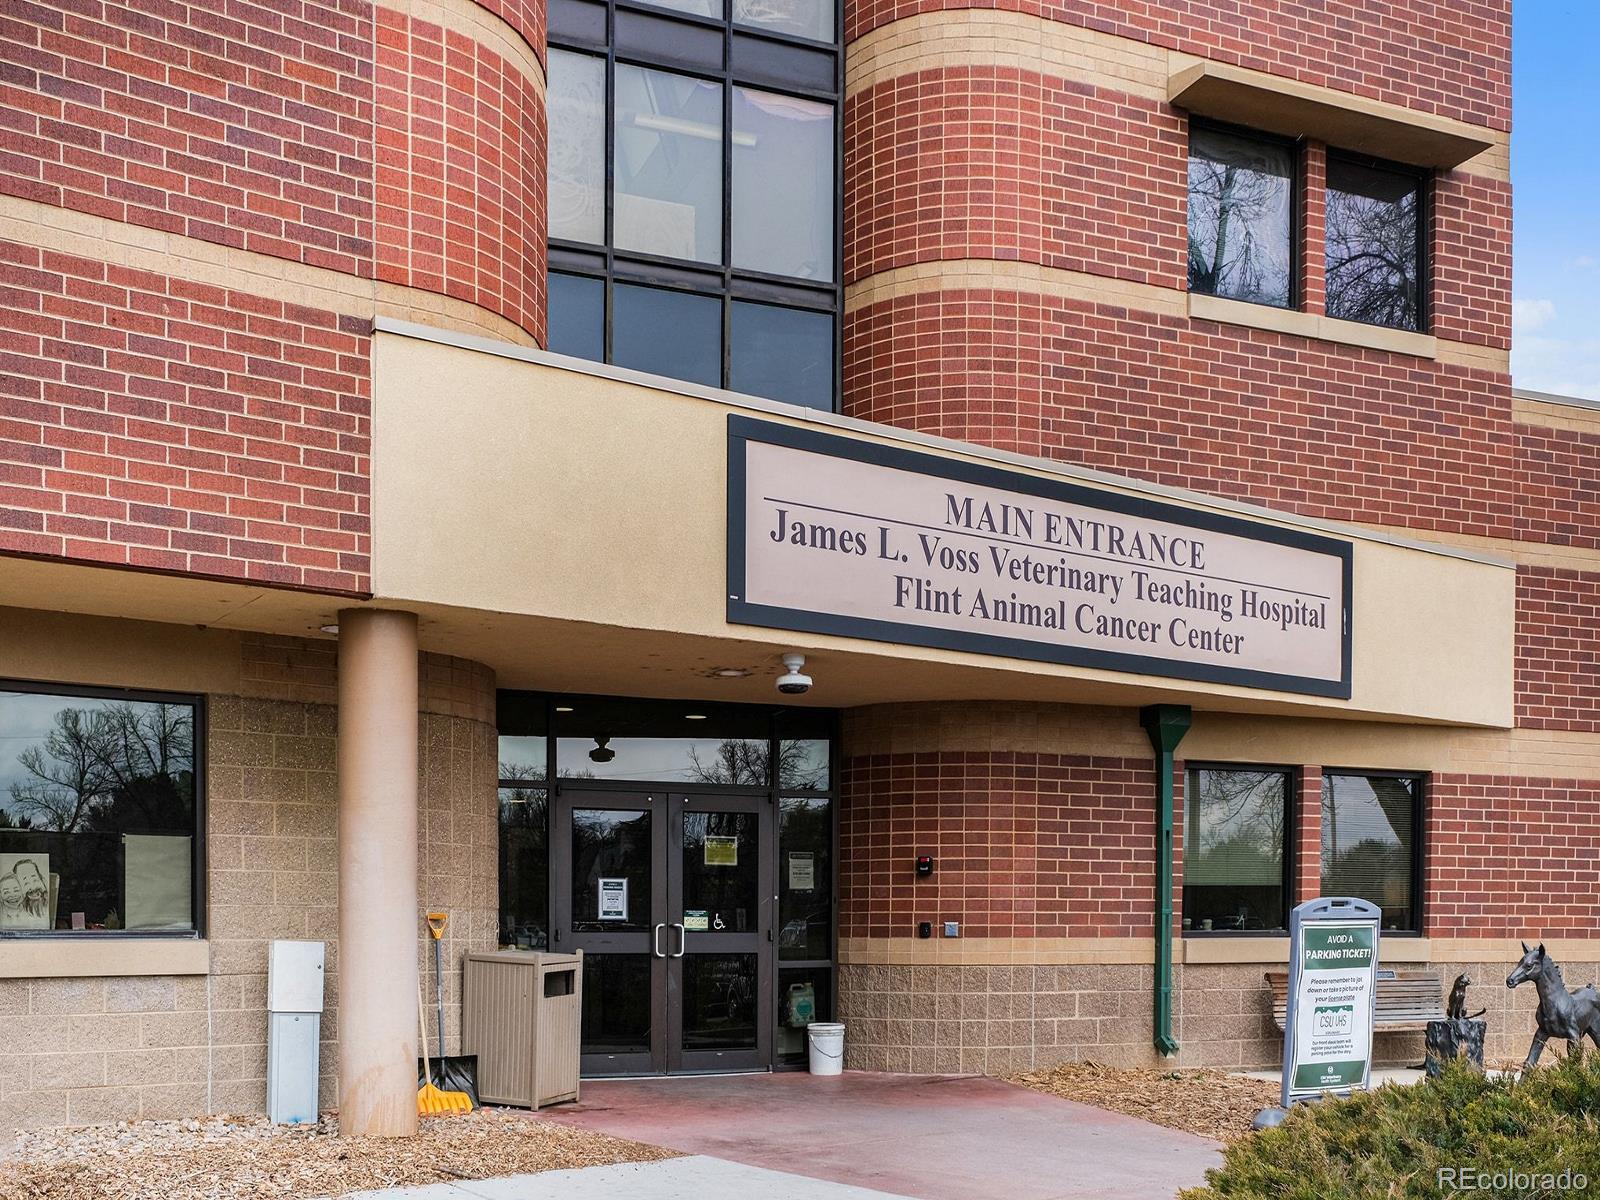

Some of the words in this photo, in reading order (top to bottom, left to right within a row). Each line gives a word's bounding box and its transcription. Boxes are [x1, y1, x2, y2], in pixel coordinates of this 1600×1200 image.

[944, 493, 1034, 540] MAIN
[1044, 512, 1206, 571] ENTRANCE
[770, 508, 867, 556] James
[878, 526, 908, 563] L.
[918, 533, 980, 574] Voss
[988, 545, 1124, 604] Veterinary
[1131, 571, 1233, 622] Teaching
[1240, 589, 1326, 631] Hospital
[893, 575, 962, 615] Flint
[969, 587, 1066, 630] Animal
[1075, 603, 1161, 643] Cancer
[1168, 617, 1245, 655] Center
[1327, 935, 1348, 944] AVOID
[1348, 935, 1354, 943] A
[1305, 949, 1342, 960] PARKING
[1342, 948, 1371, 959] TICKET!
[1342, 985, 1358, 993] picture
[1320, 1015, 1334, 1028] CSU
